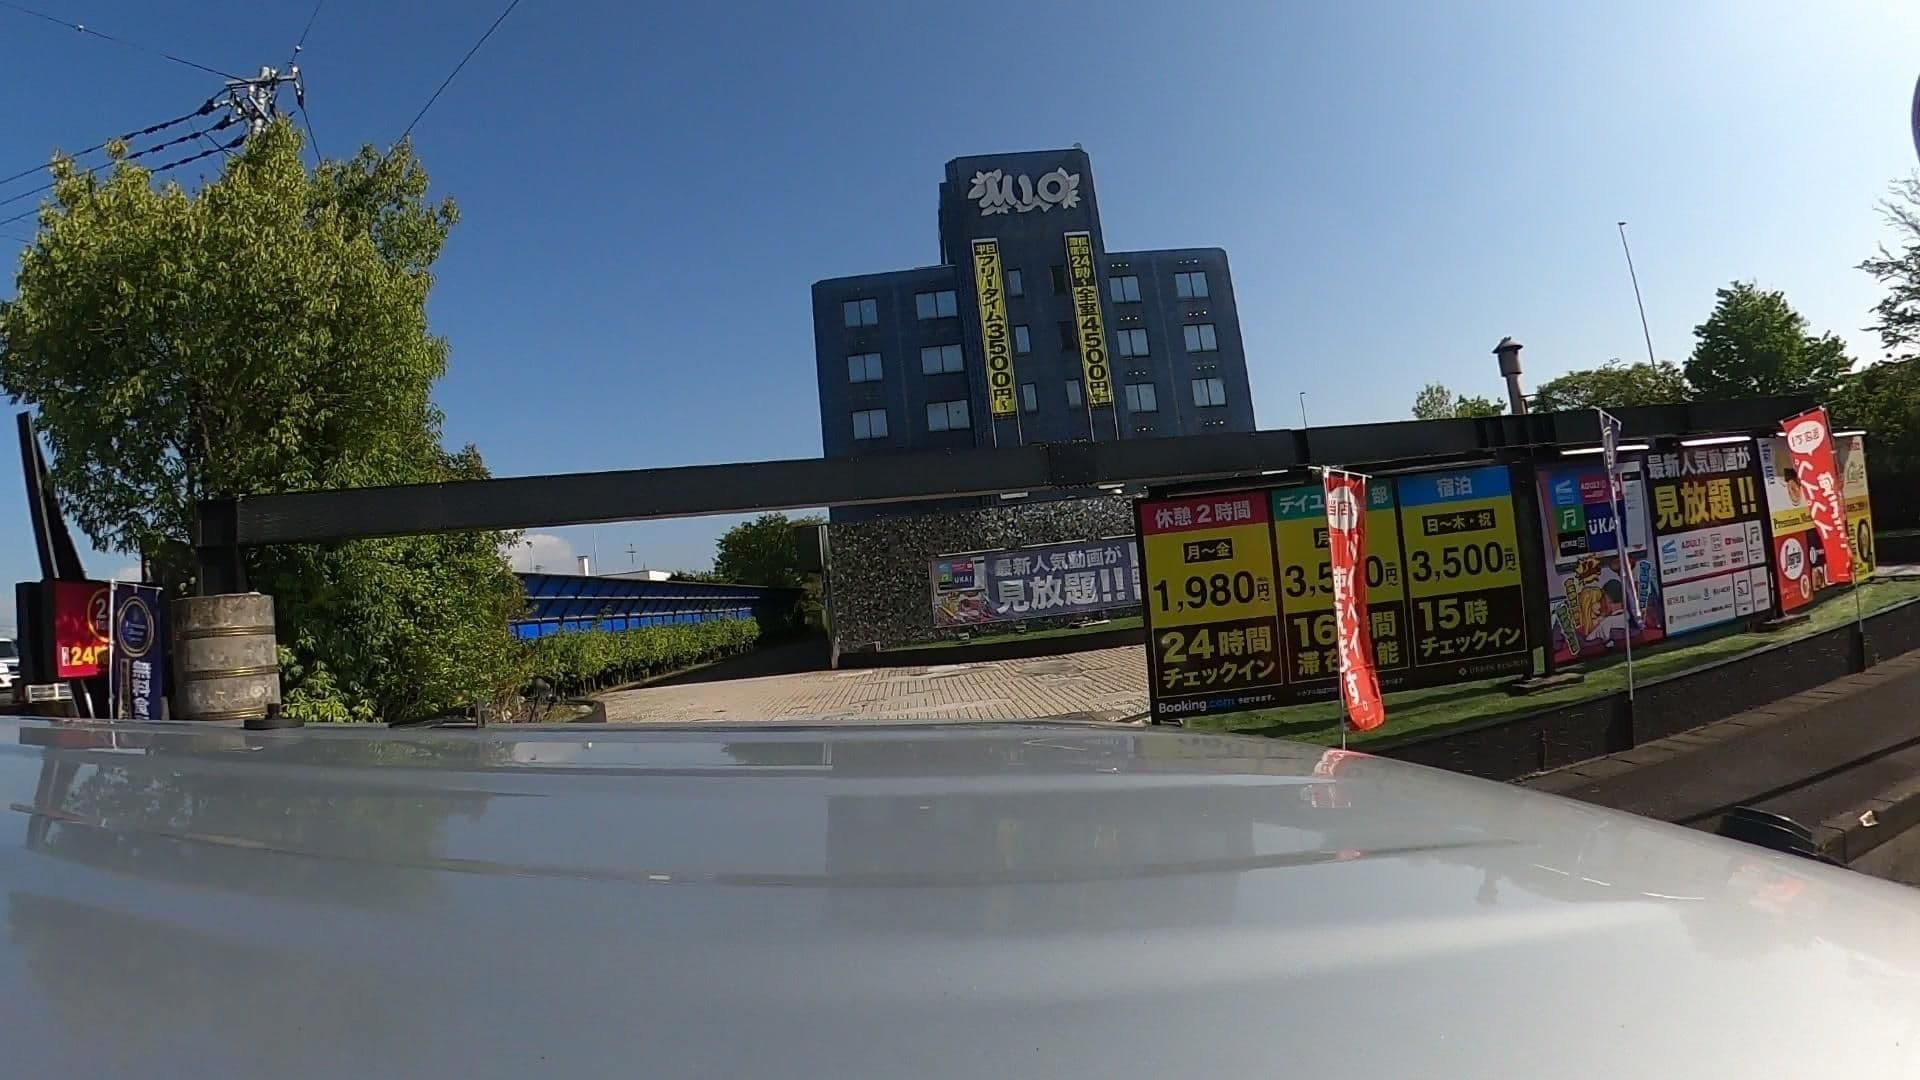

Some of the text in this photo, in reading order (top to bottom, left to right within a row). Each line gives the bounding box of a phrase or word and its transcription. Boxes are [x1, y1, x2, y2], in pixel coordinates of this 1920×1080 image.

[1648, 446, 1751, 479] 最新人気動画が
[1437, 475, 1473, 497] 宿泊
[1155, 500, 1251, 528] 休憩2時間
[995, 545, 1123, 577] 最新人気動画が
[1187, 542, 1231, 560] 月～金
[1418, 598, 1488, 631] 15時
[1161, 626, 1272, 663] 24時間
[1421, 627, 1520, 657] チェックイン
[1163, 660, 1275, 689] チェックイン
